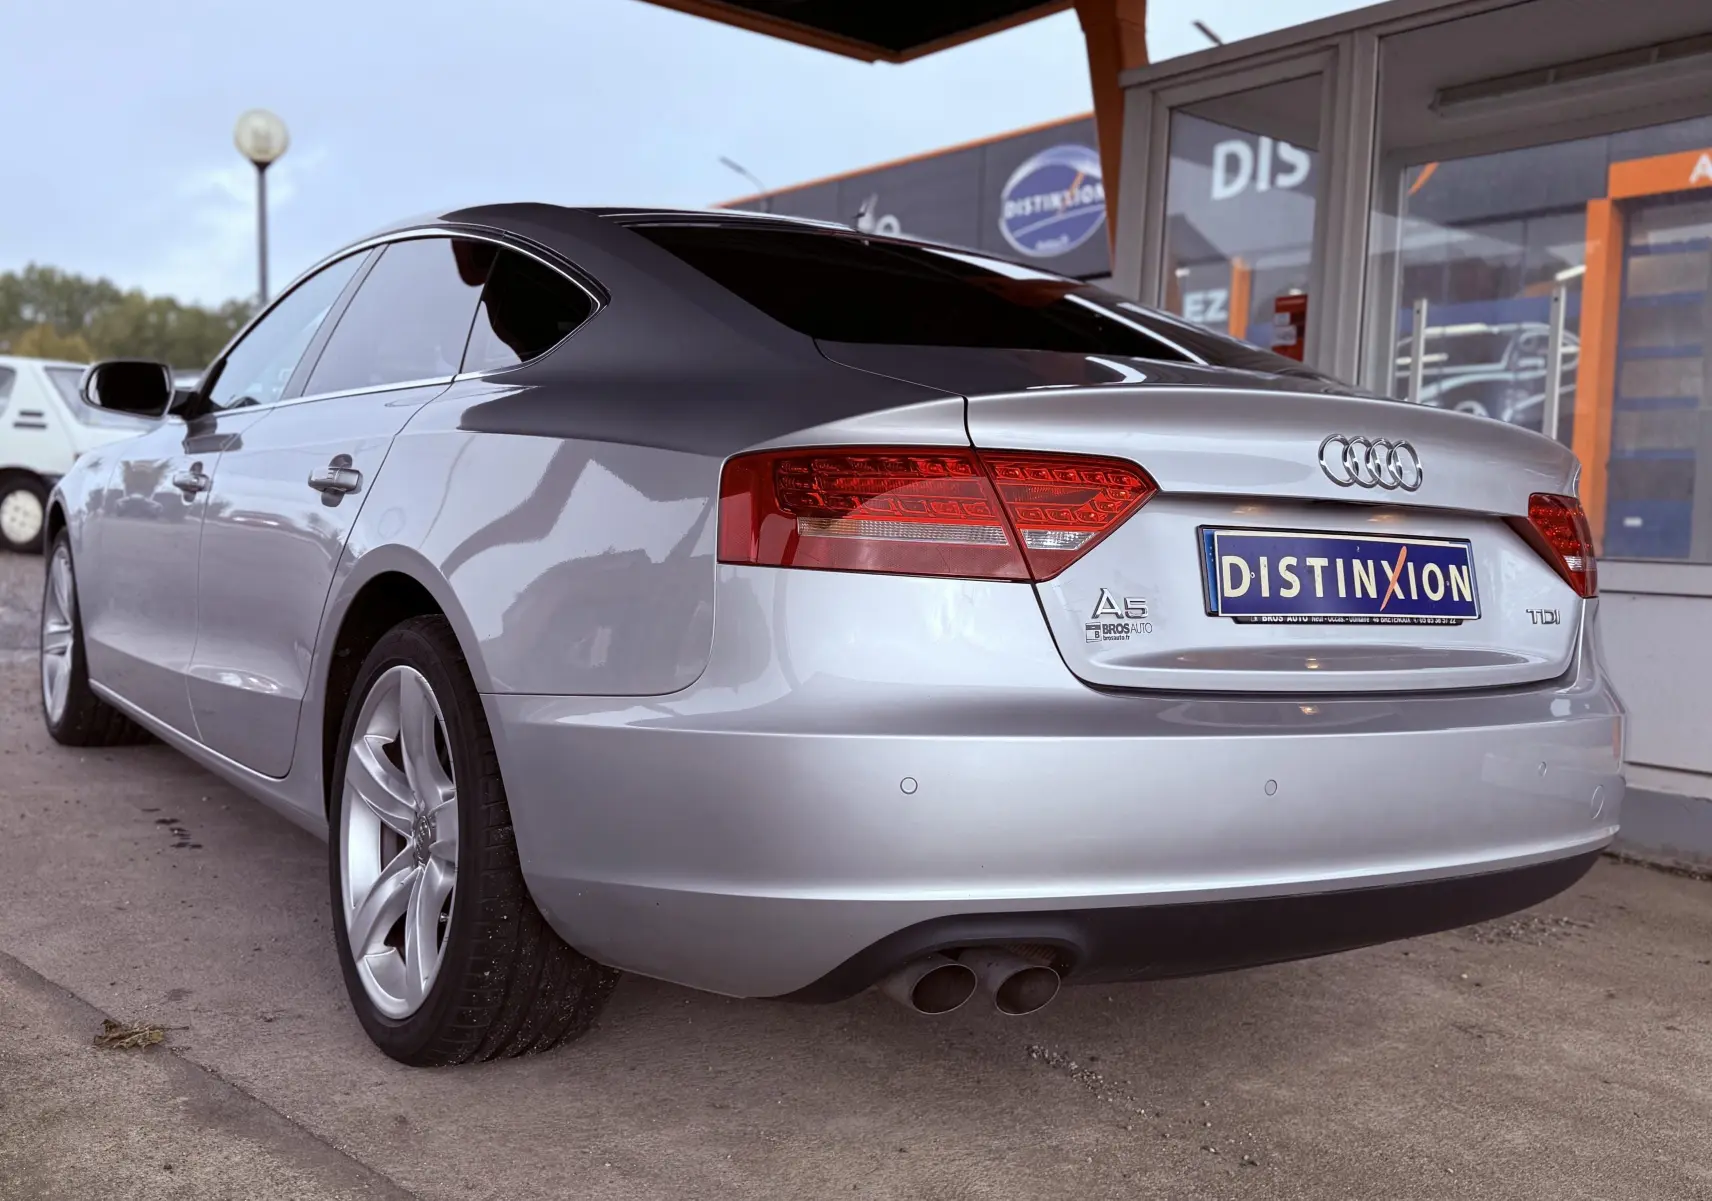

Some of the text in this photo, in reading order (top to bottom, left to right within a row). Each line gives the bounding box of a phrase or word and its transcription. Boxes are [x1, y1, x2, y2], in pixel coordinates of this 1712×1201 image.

[1221, 547, 1473, 611] DISTINXION
[1091, 588, 1148, 619] A5
[1525, 609, 1561, 625] TDI
